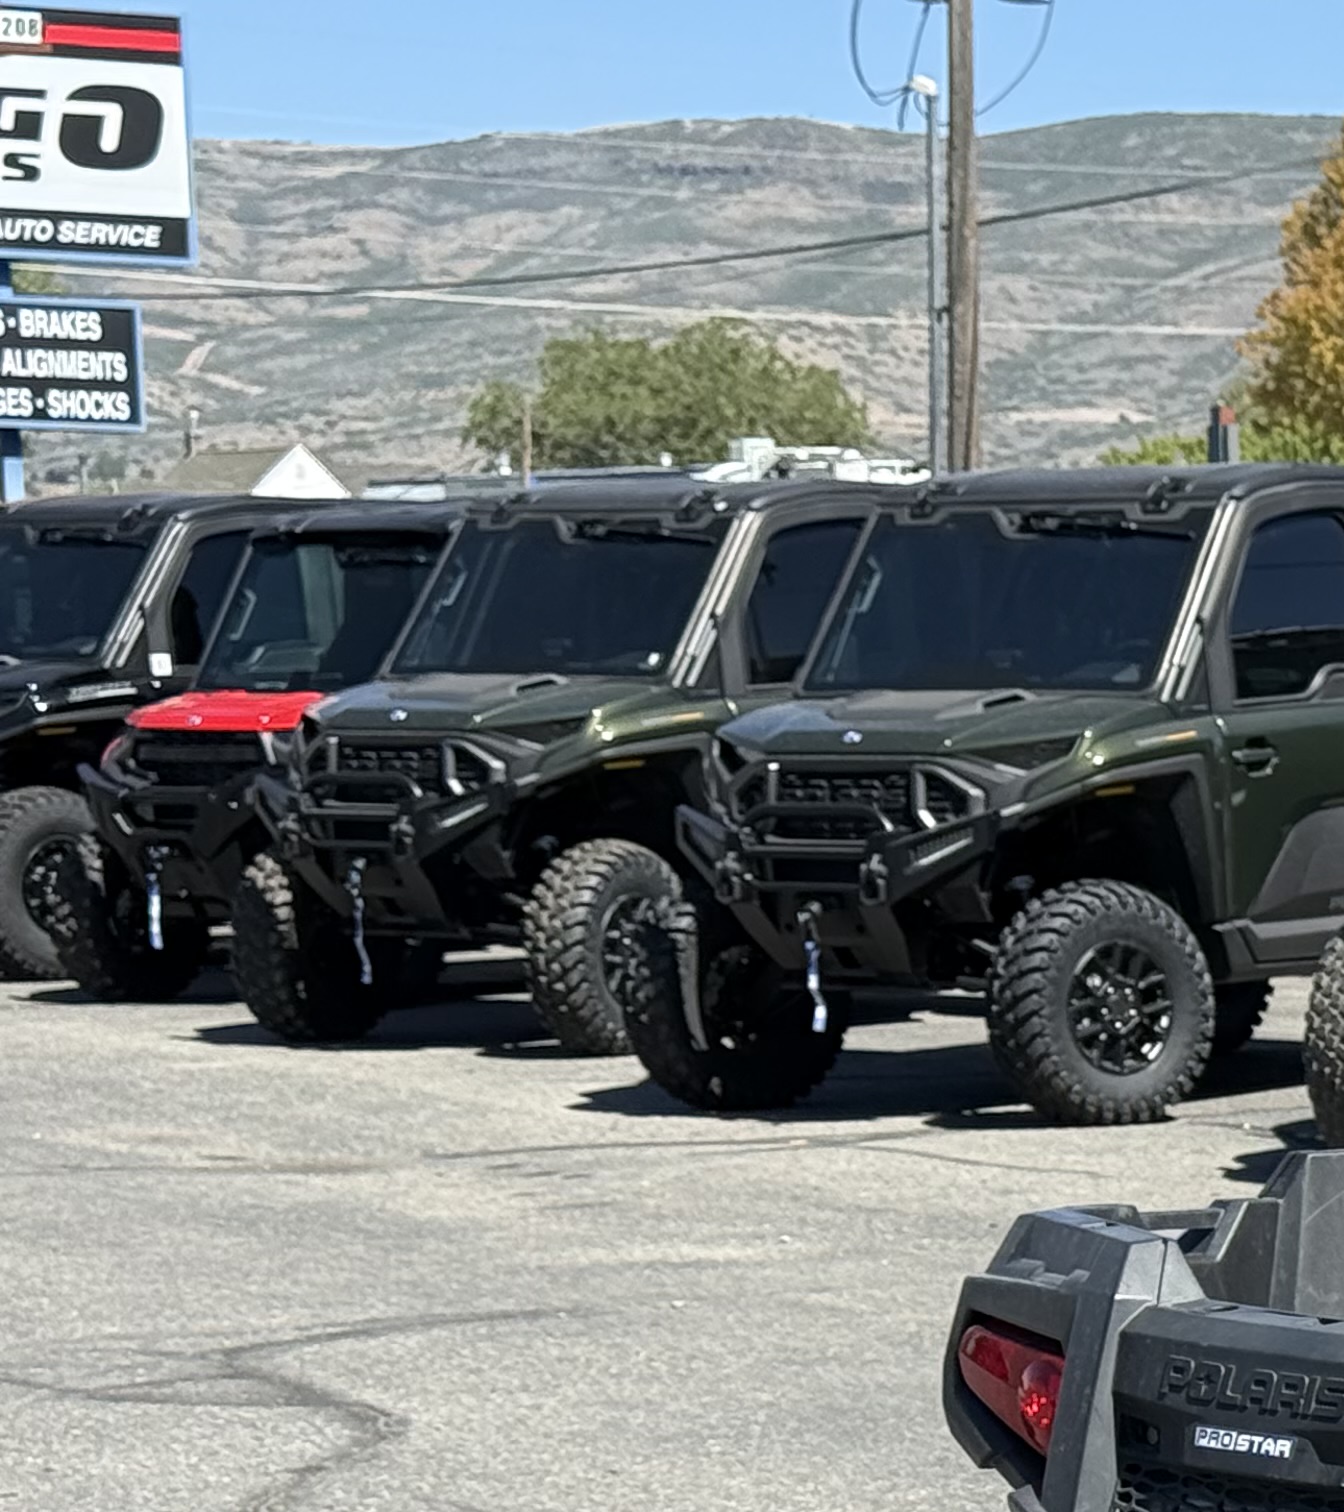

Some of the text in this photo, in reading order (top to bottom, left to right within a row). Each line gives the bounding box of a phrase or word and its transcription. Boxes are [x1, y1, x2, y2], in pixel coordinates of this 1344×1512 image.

[0, 217, 163, 249] UTO SERVICE
[19, 308, 103, 342] BRAKES
[2, 347, 128, 383] ALIGNMENTS
[46, 388, 131, 421] SHOCKS
